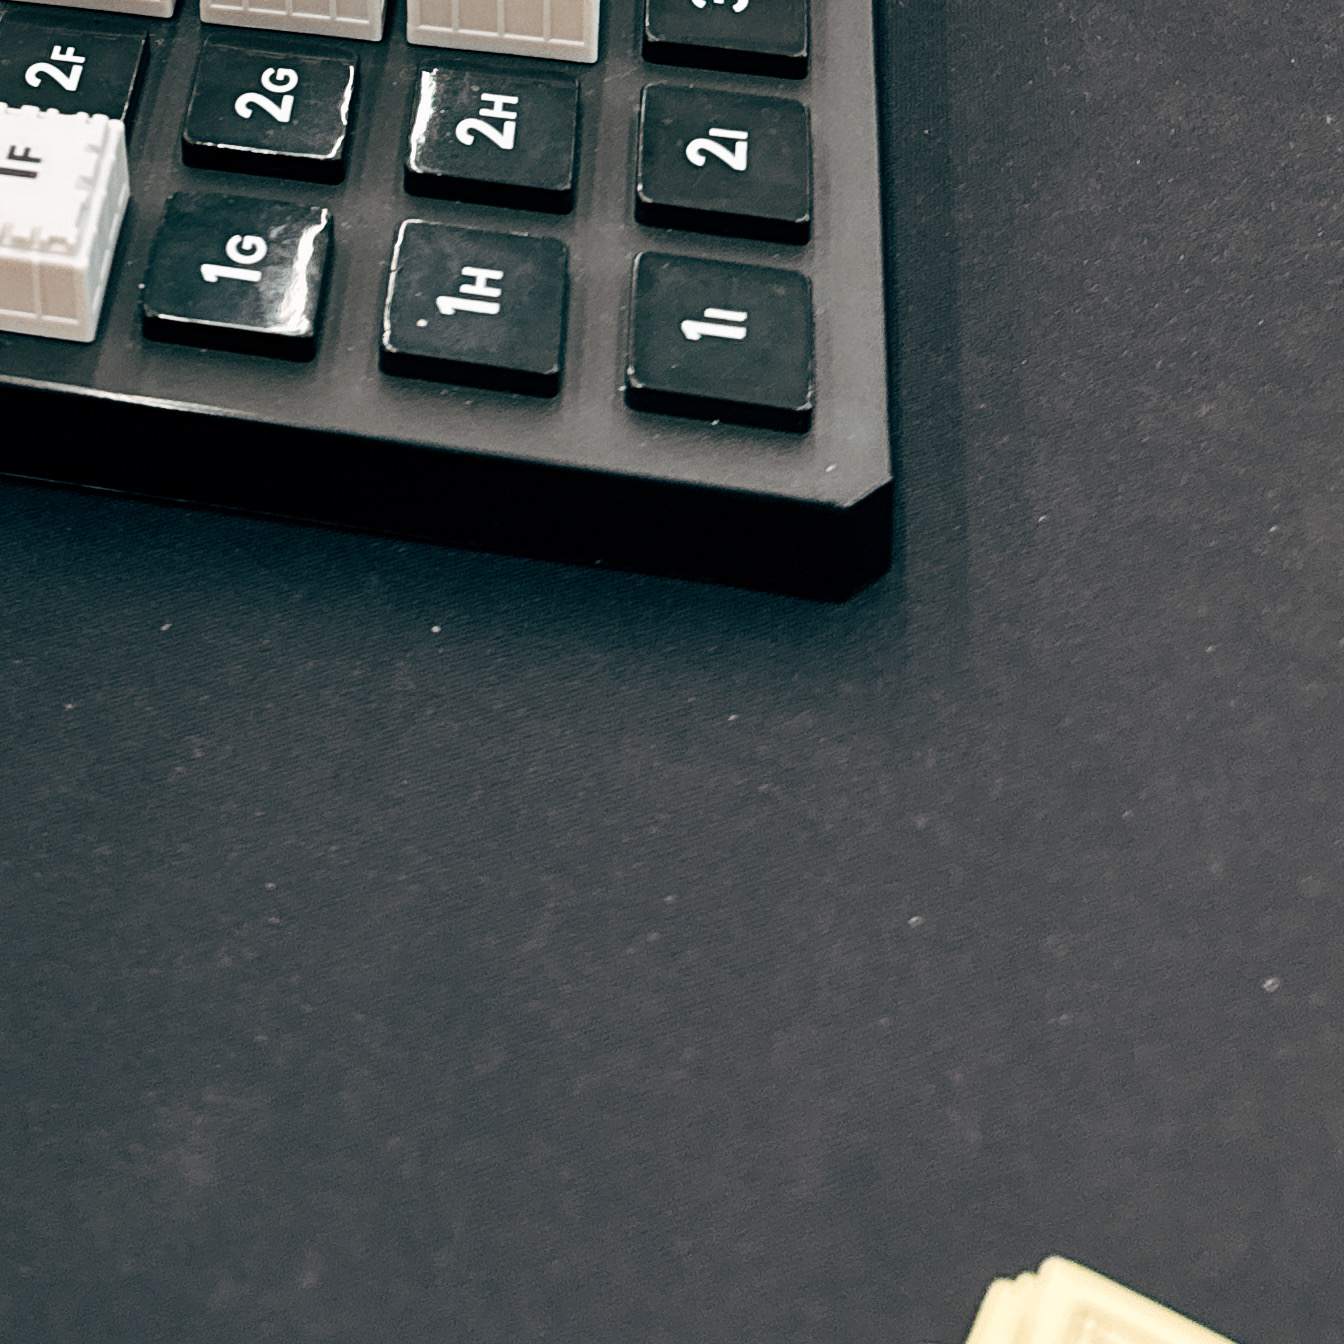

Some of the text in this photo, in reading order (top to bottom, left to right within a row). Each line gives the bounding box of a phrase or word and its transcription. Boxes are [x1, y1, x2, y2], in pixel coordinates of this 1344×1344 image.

[24, 45, 86, 92] 2F
[234, 67, 299, 123] 2G
[455, 93, 519, 151] 2H
[685, 128, 748, 172] 2I
[200, 234, 268, 284] 1G
[436, 266, 504, 315] 1H
[680, 308, 748, 341] 1I
